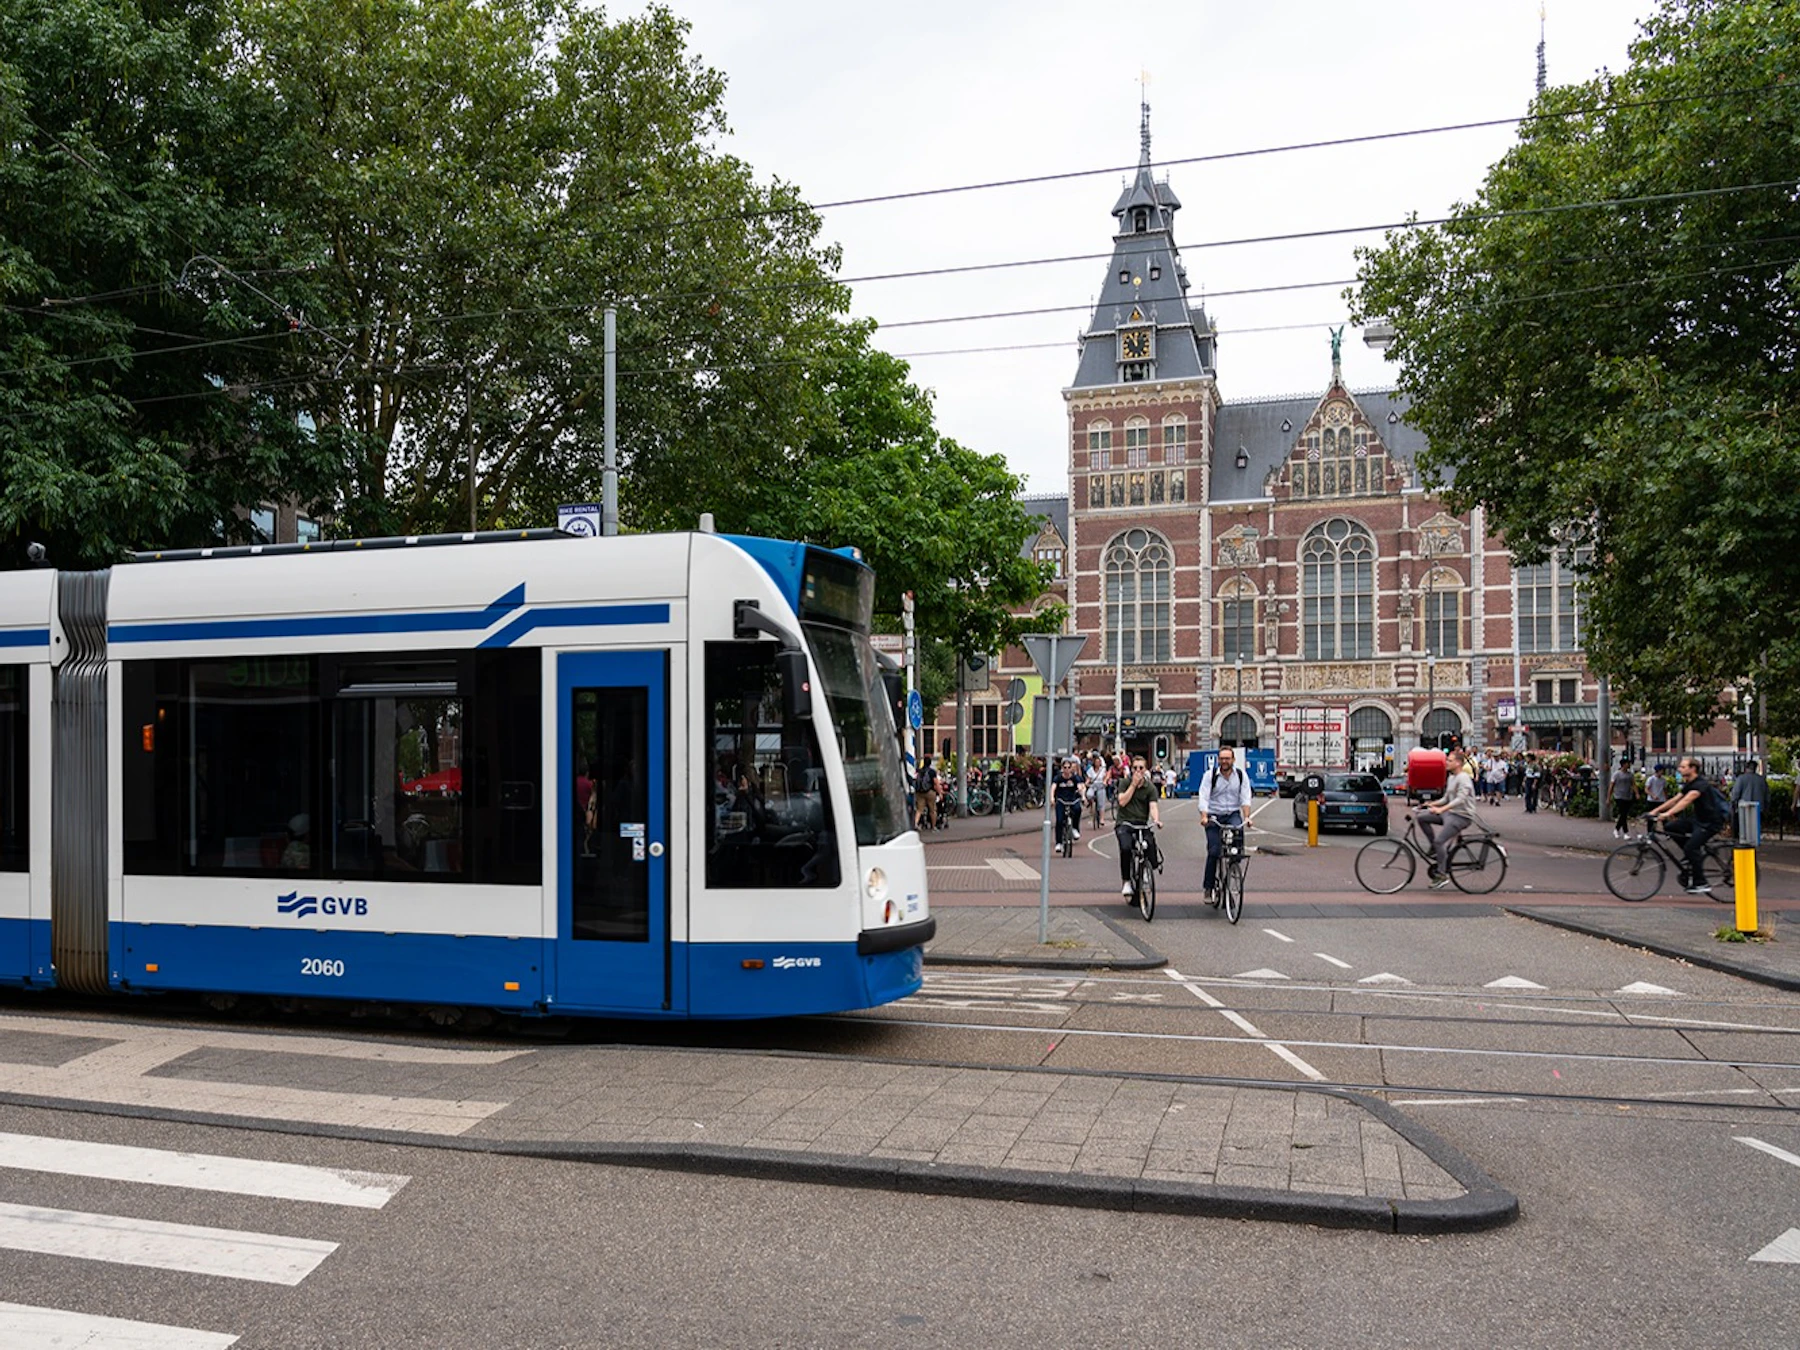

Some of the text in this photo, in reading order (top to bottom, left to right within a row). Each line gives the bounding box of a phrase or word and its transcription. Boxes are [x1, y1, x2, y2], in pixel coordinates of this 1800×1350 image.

[321, 897, 368, 916] GVB
[301, 958, 344, 977] 2060
[796, 957, 821, 967] GVB
